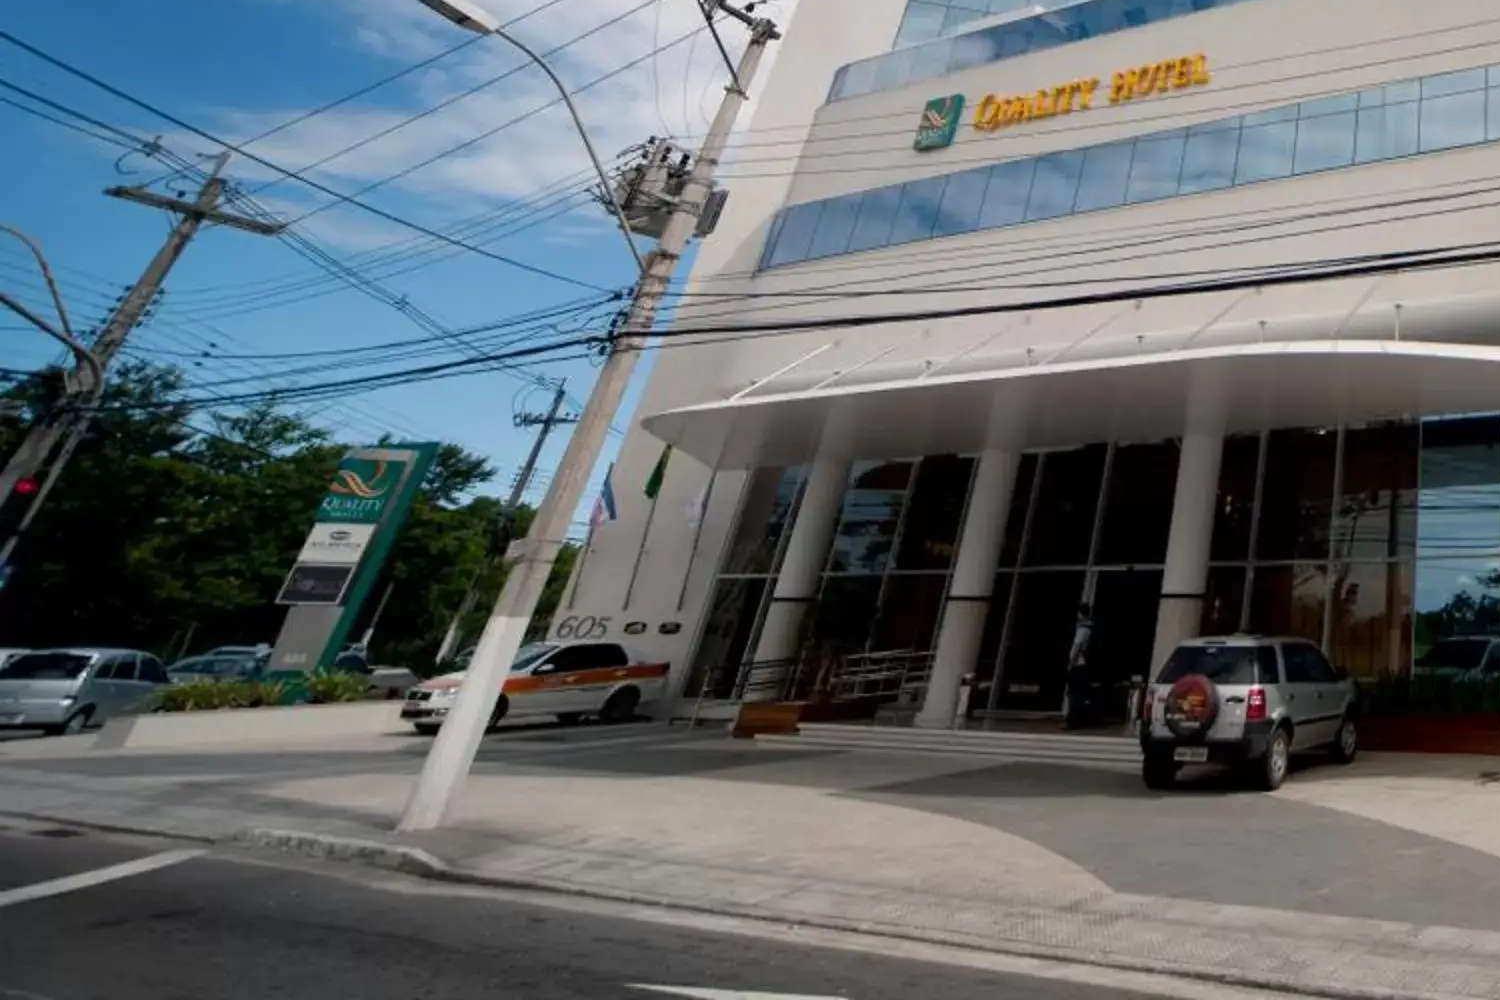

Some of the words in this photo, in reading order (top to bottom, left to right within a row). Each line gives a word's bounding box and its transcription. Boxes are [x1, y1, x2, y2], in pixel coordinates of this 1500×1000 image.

[973, 78, 1100, 132] QUALITY
[1109, 53, 1212, 104] HOTEL
[321, 496, 385, 512] QUALITY
[556, 615, 612, 640] 605
